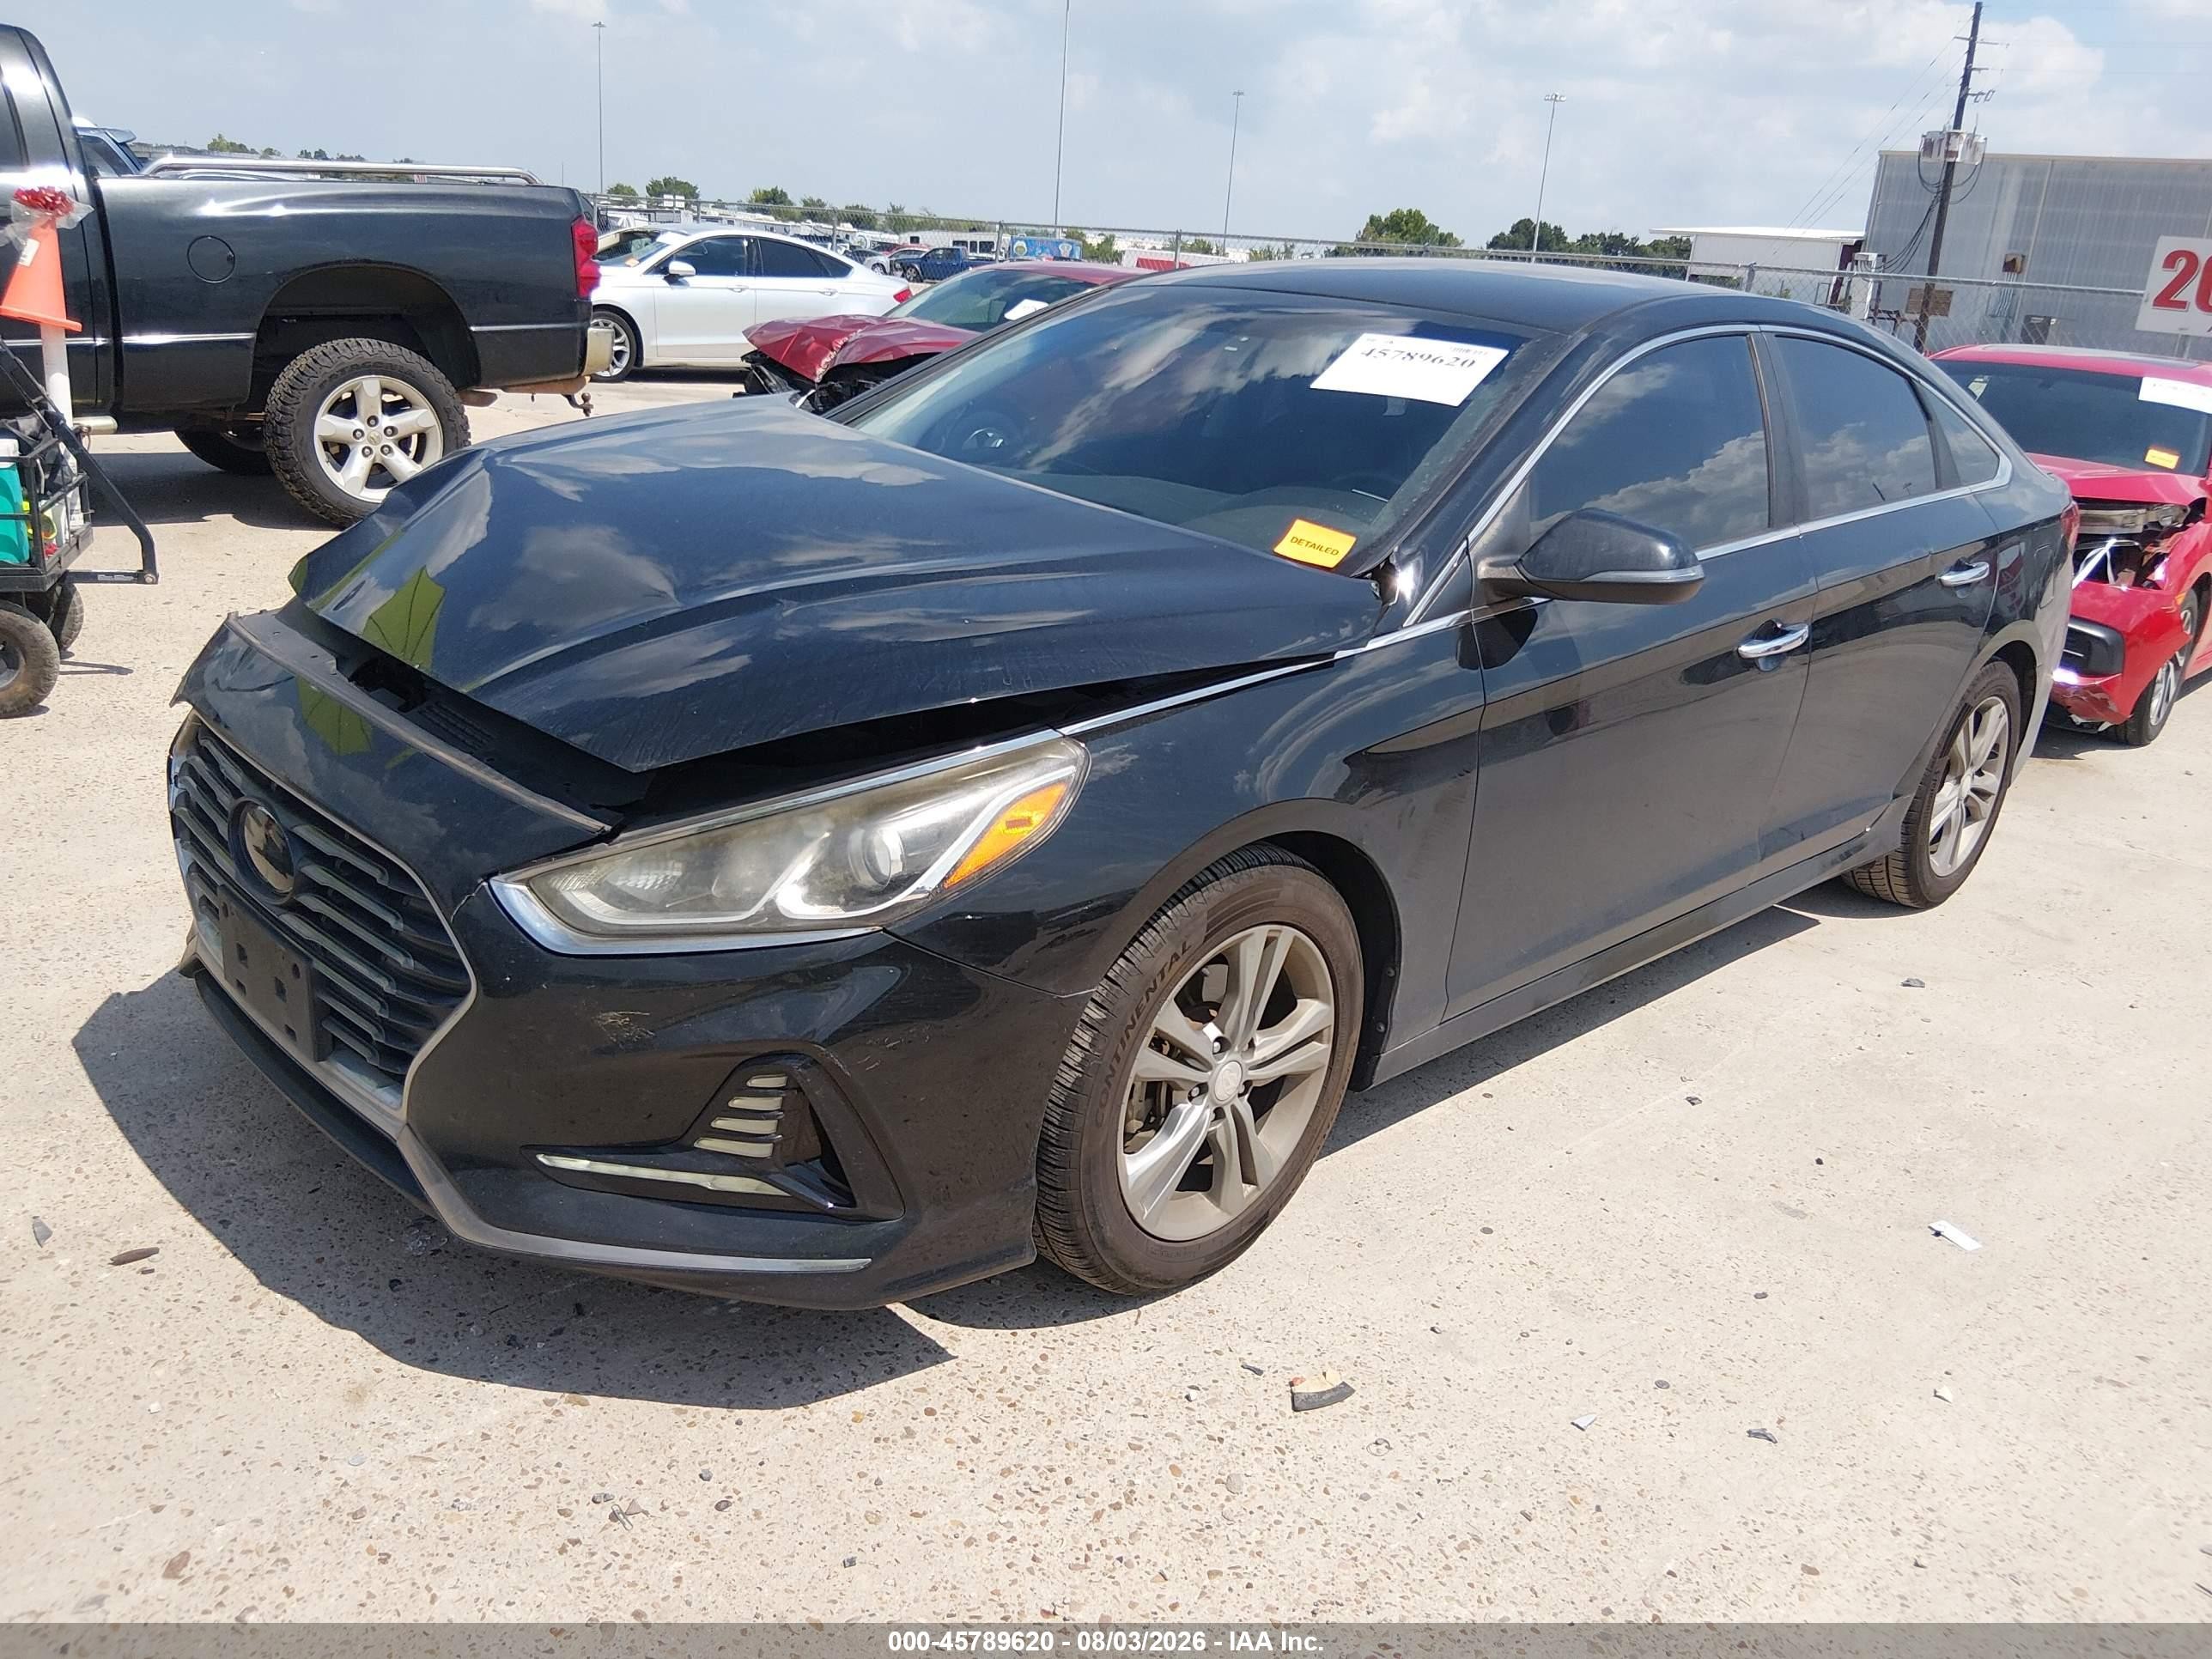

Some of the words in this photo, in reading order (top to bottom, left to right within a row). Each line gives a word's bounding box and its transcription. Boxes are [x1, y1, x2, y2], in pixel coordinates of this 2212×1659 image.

[1360, 347, 1476, 368] 45789620
[1290, 536, 1340, 556] DETAILED
[1094, 940, 1189, 1128] CONTINENTAL
